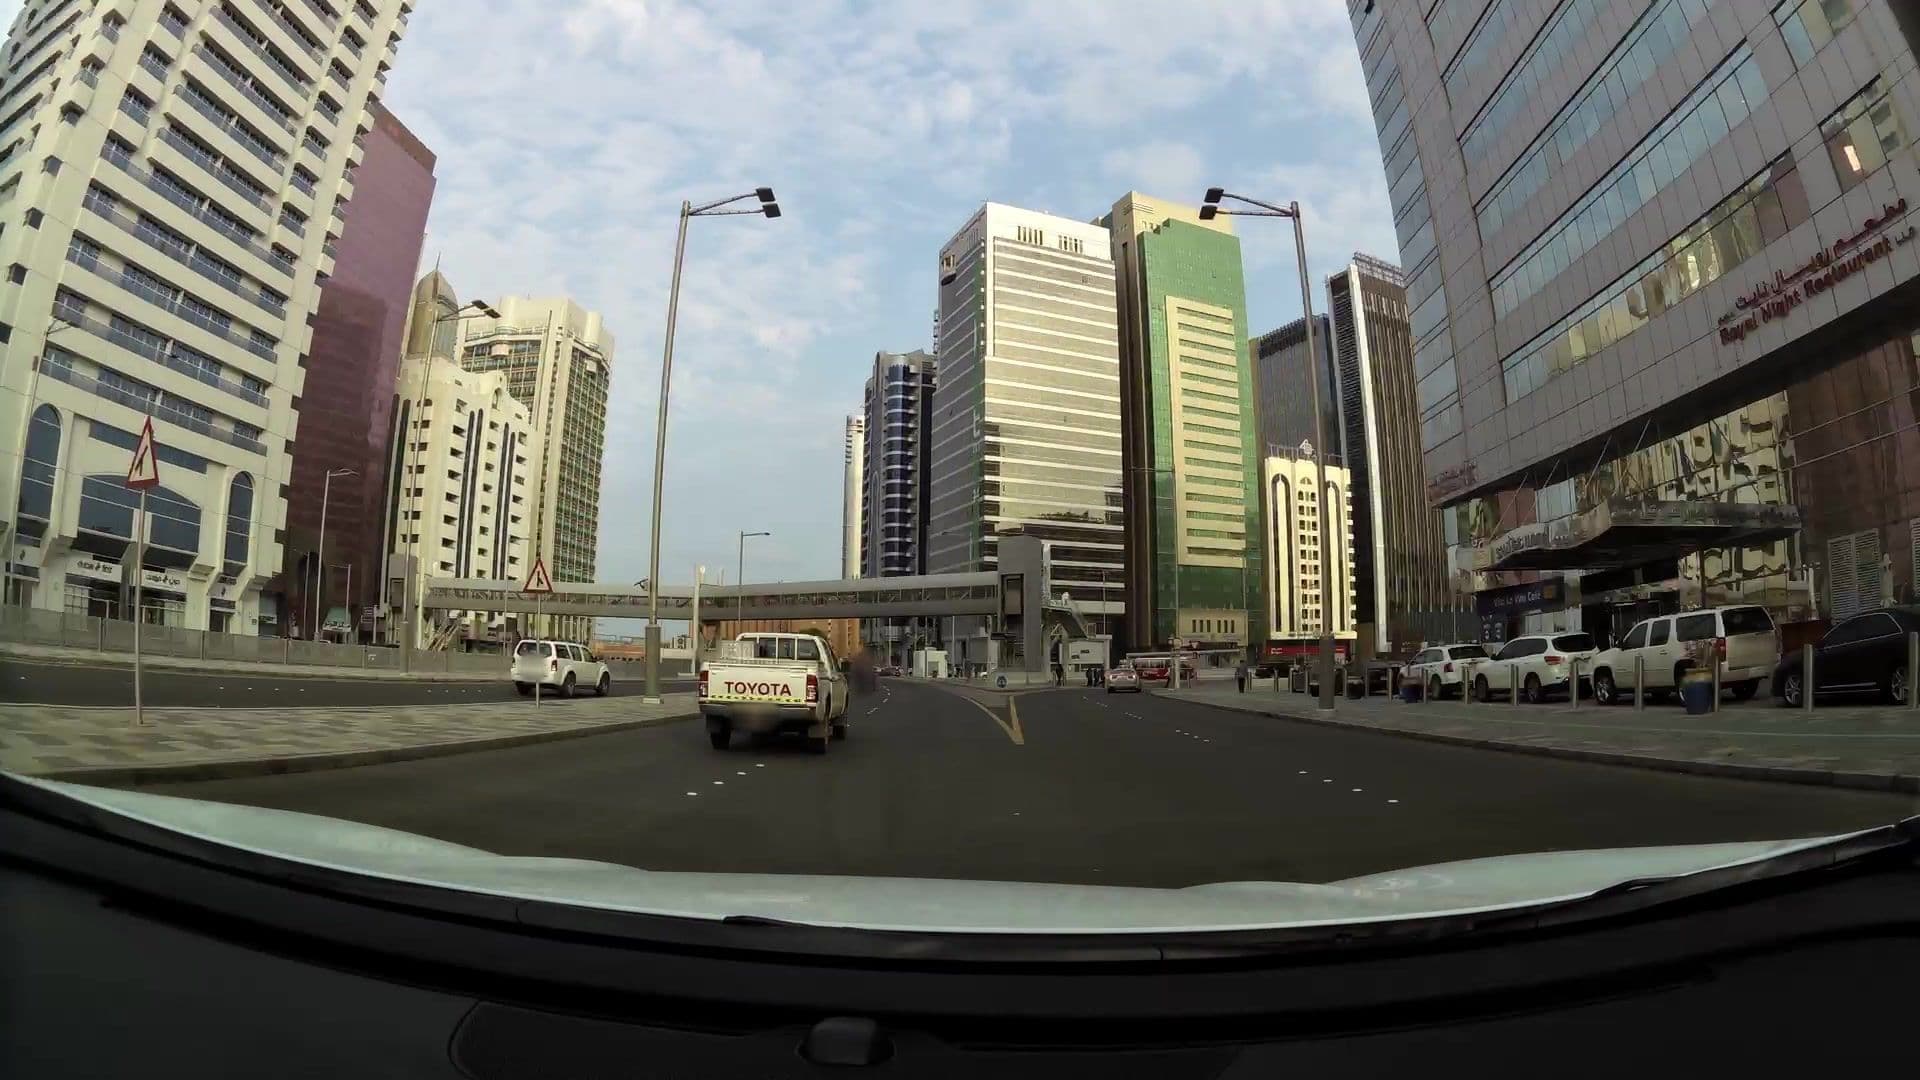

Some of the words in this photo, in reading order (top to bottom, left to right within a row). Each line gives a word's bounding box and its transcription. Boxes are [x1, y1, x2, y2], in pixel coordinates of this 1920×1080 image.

[1719, 312, 1758, 346] Royal
[1760, 290, 1803, 324] Night
[1804, 238, 1893, 298] Restaurant
[724, 682, 792, 696] TOYOTA
